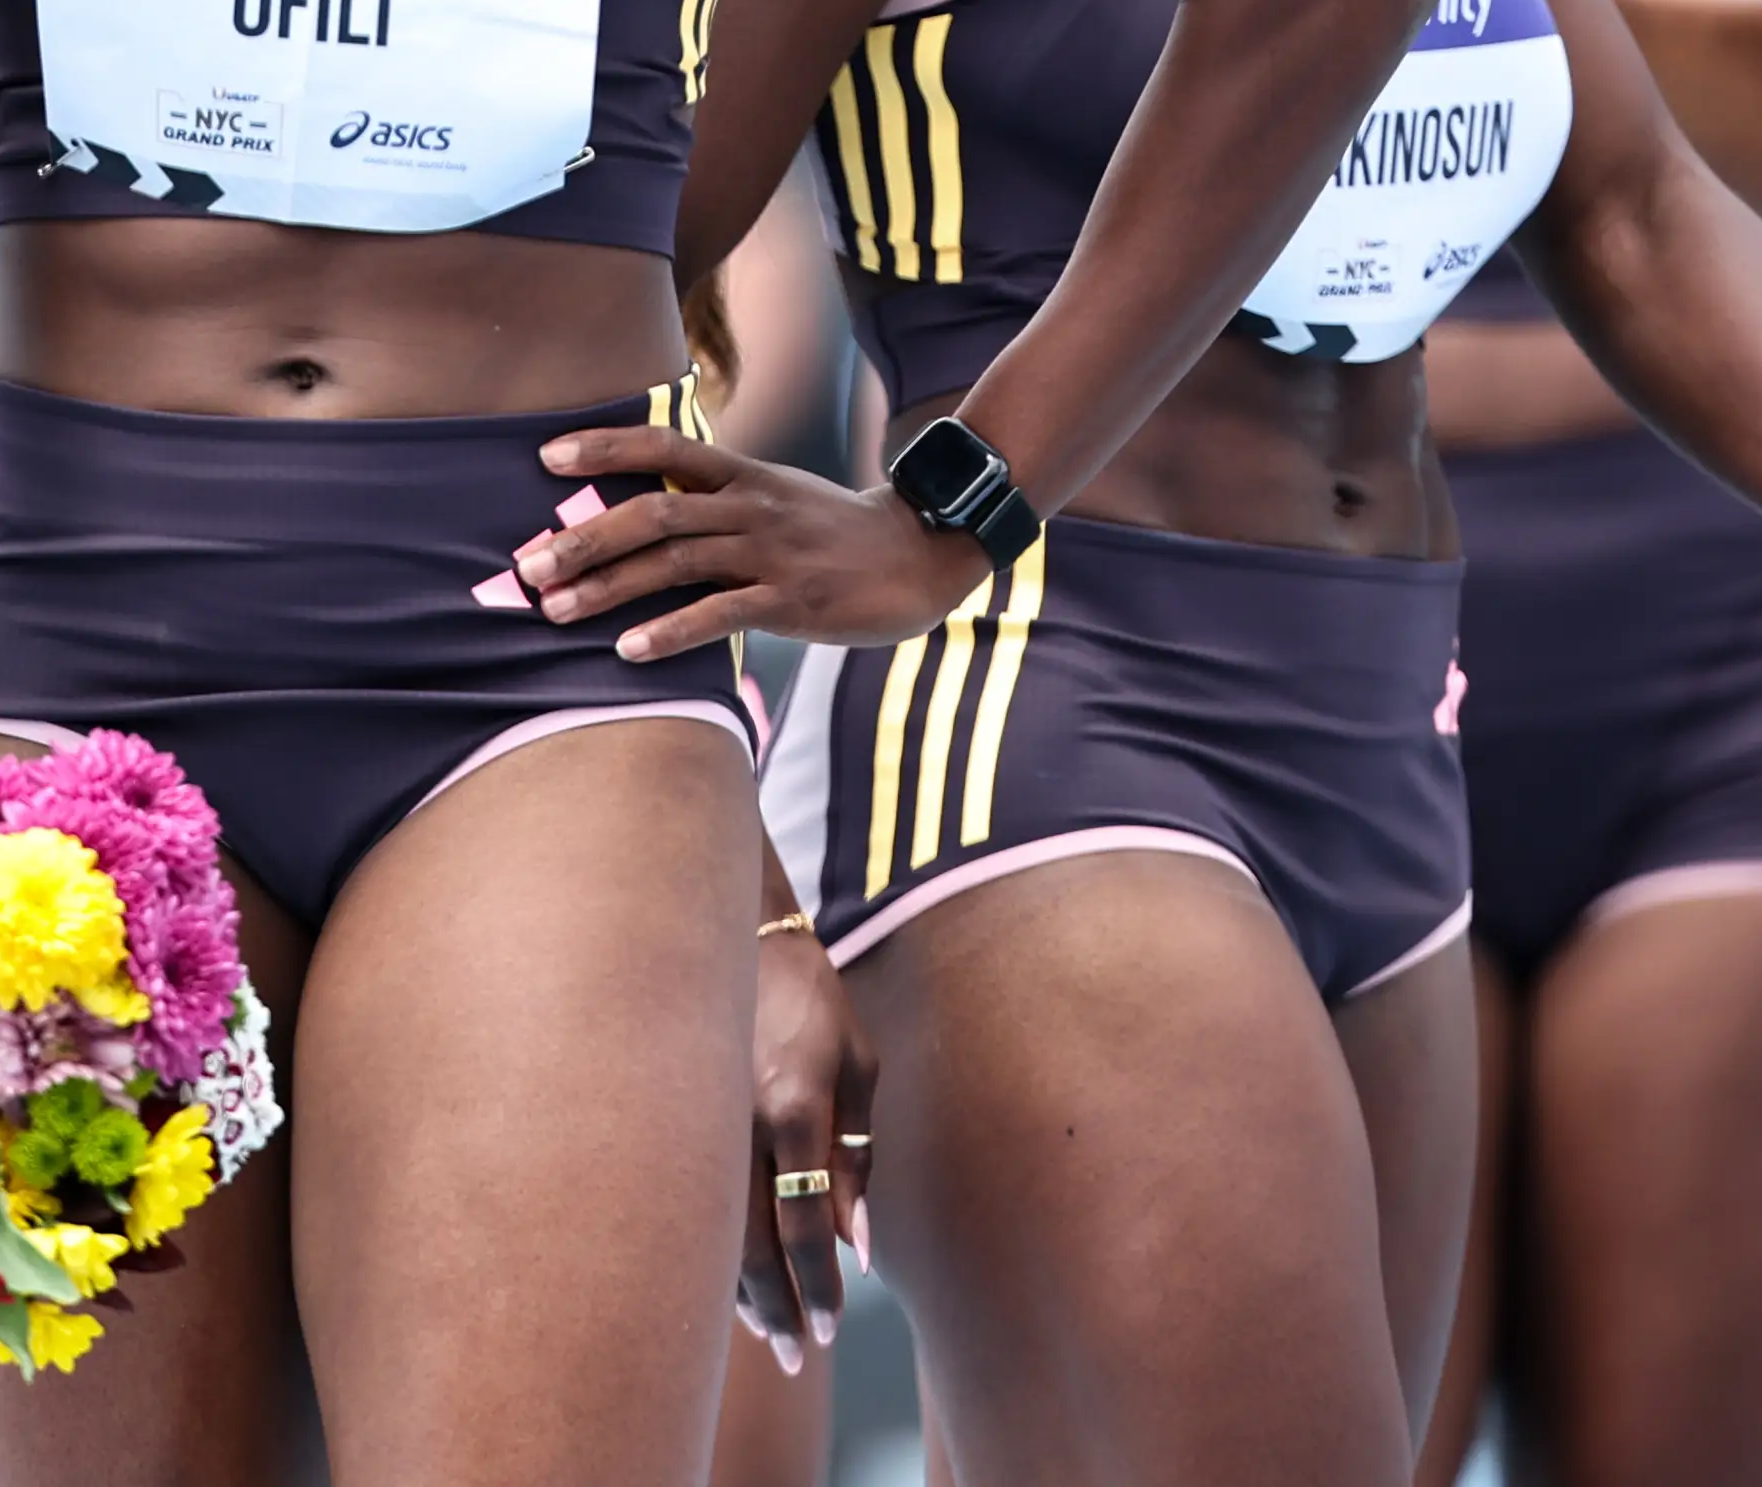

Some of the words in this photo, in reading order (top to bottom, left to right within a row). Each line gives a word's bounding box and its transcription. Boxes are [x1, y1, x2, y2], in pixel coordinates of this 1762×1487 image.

[195, 107, 243, 133] NYC
[163, 126, 225, 146] GRAND
[231, 136, 274, 152] PRIX
[370, 122, 453, 151] asics
